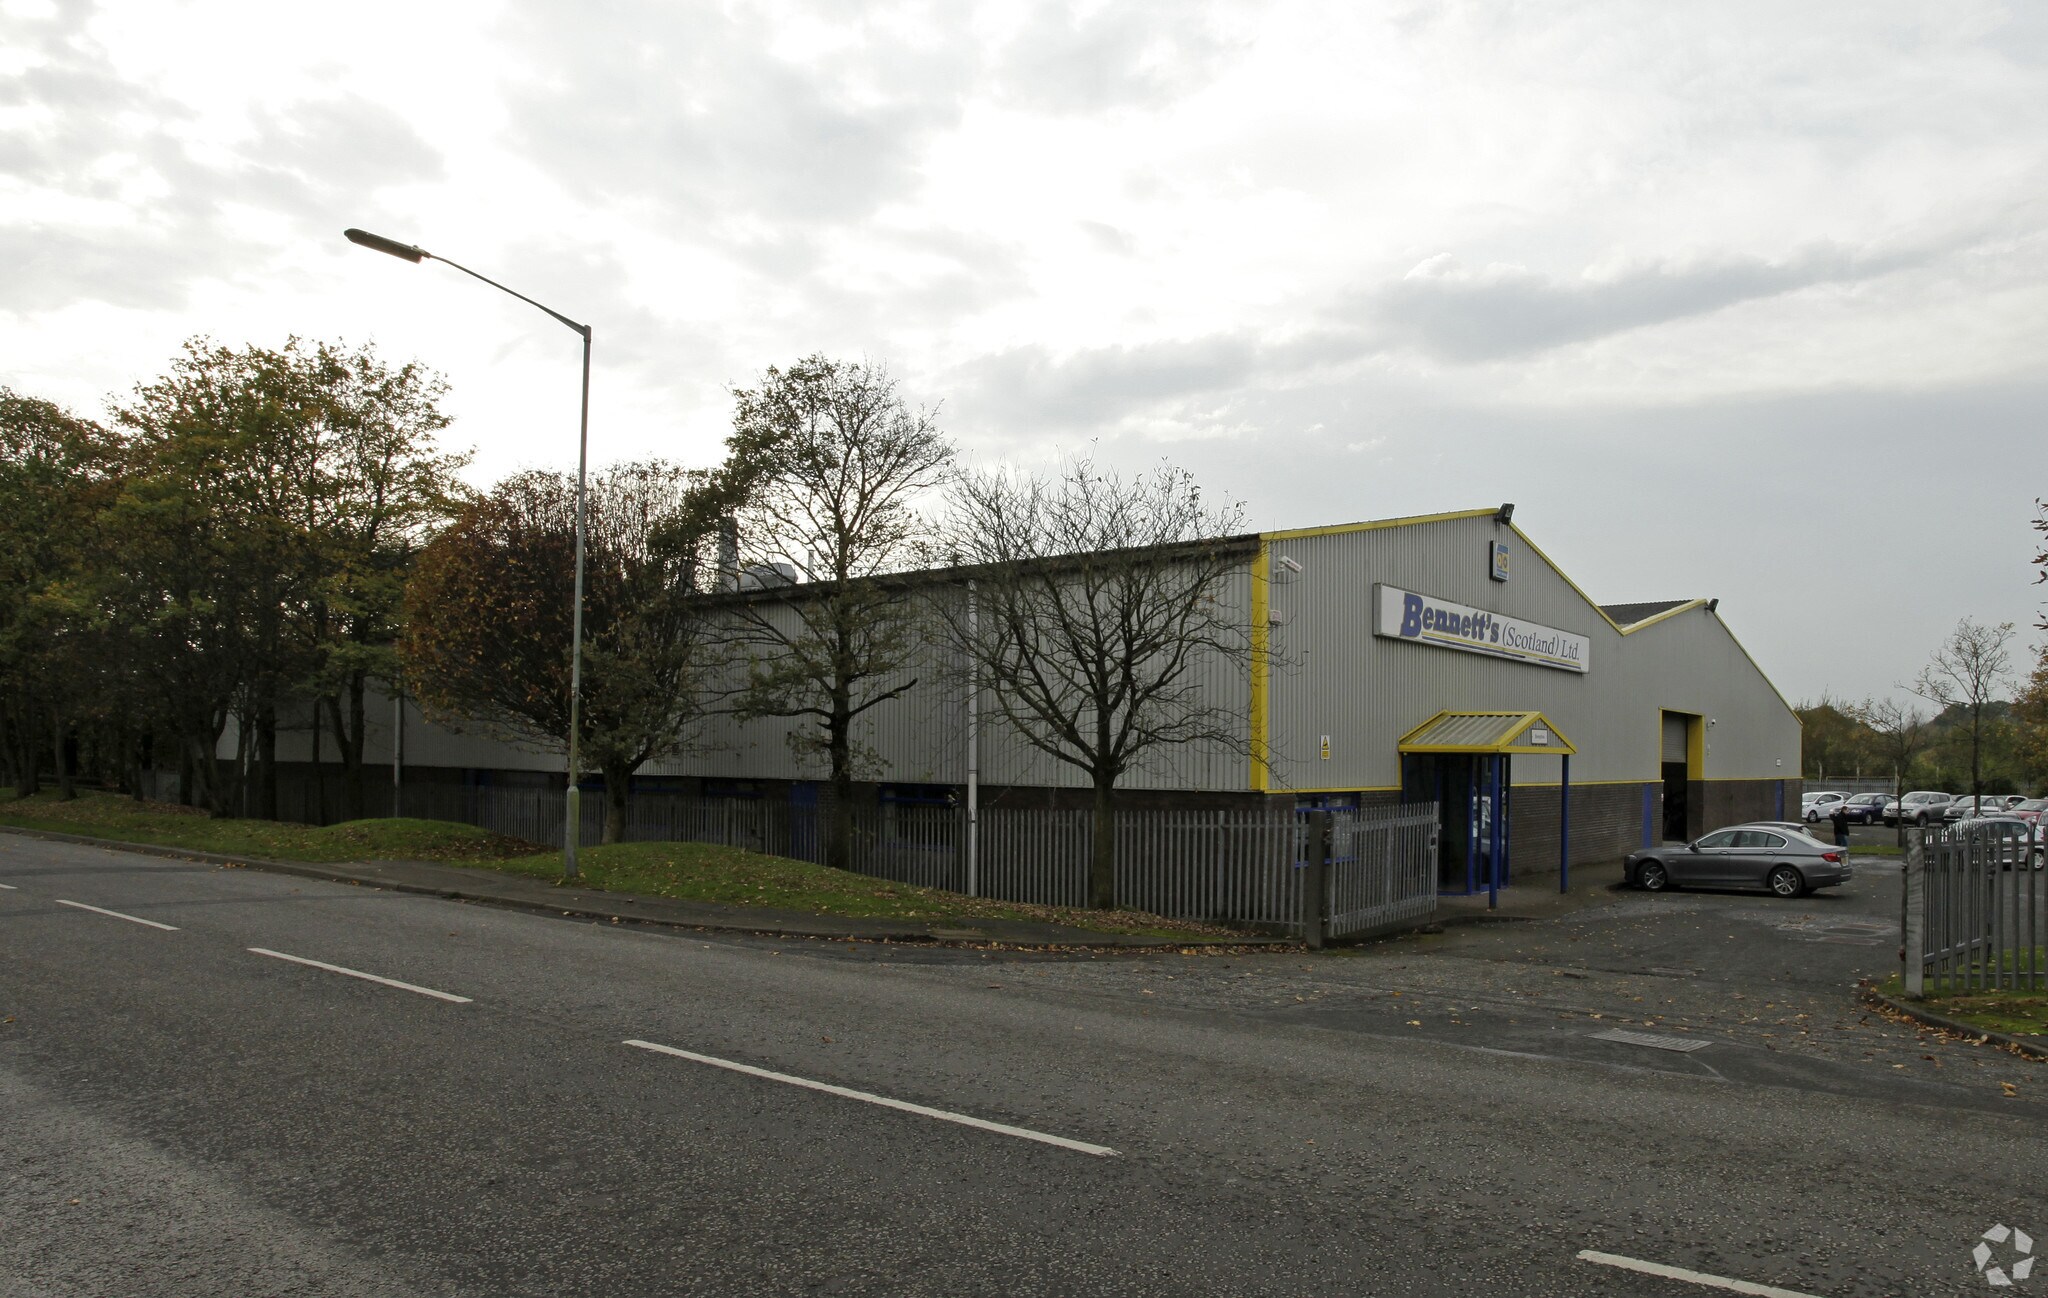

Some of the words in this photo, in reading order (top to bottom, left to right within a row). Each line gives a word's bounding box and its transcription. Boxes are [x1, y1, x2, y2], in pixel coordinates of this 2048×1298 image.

[1400, 592, 1500, 643] Bennett's
[1502, 621, 1560, 656] (Scotland)
[1561, 639, 1580, 660] Ltd.
